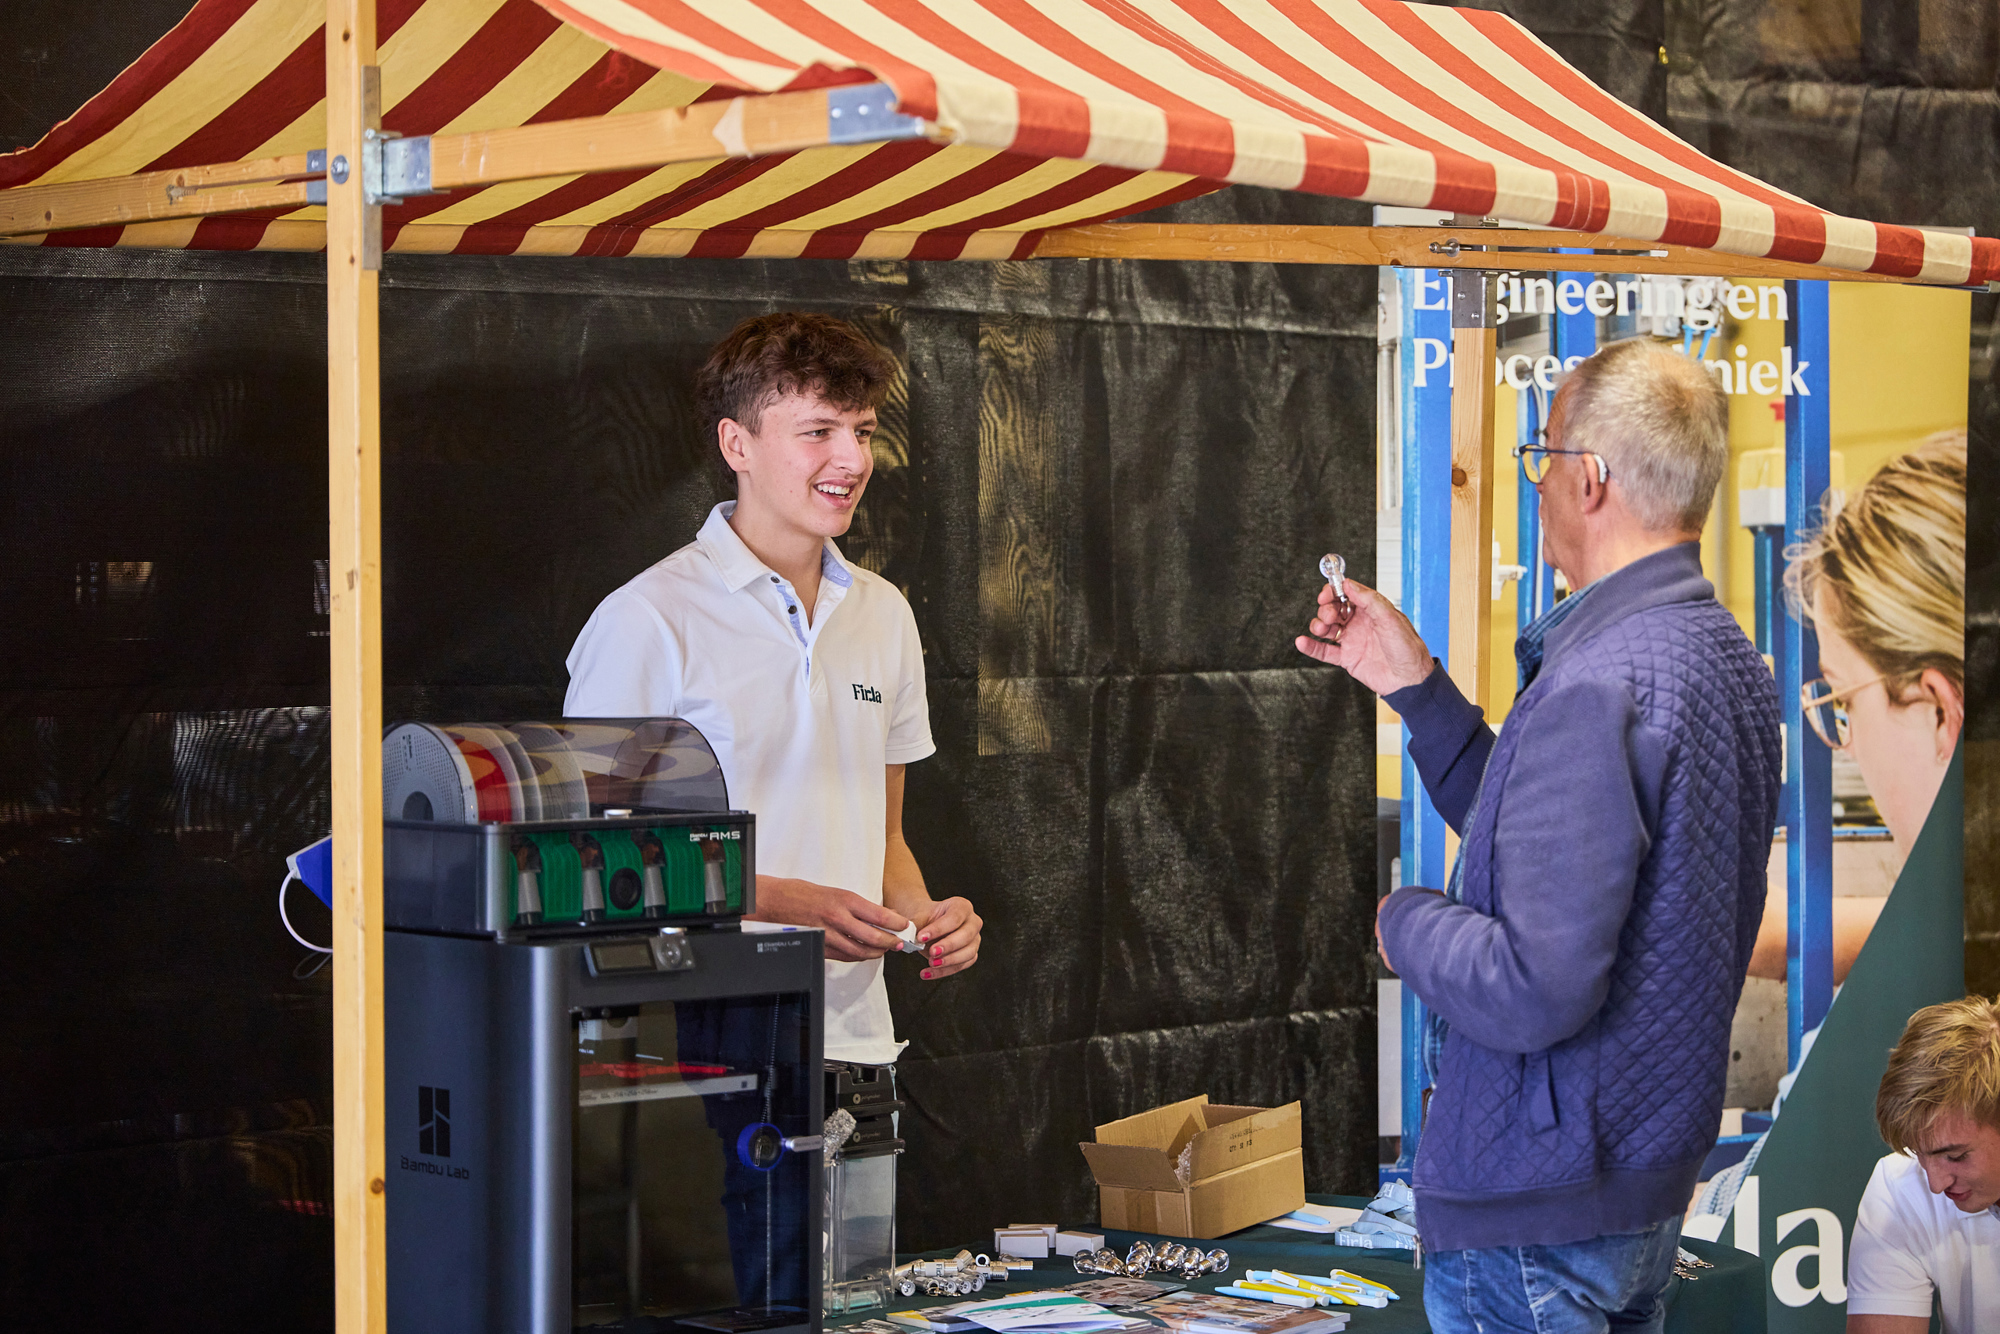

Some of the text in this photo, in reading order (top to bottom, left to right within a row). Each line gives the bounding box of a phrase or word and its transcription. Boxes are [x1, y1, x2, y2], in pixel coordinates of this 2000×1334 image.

[1413, 268, 1789, 331] Eineering en
[710, 831, 741, 840] AMS
[400, 1155, 470, 1180] Bambu Lab
